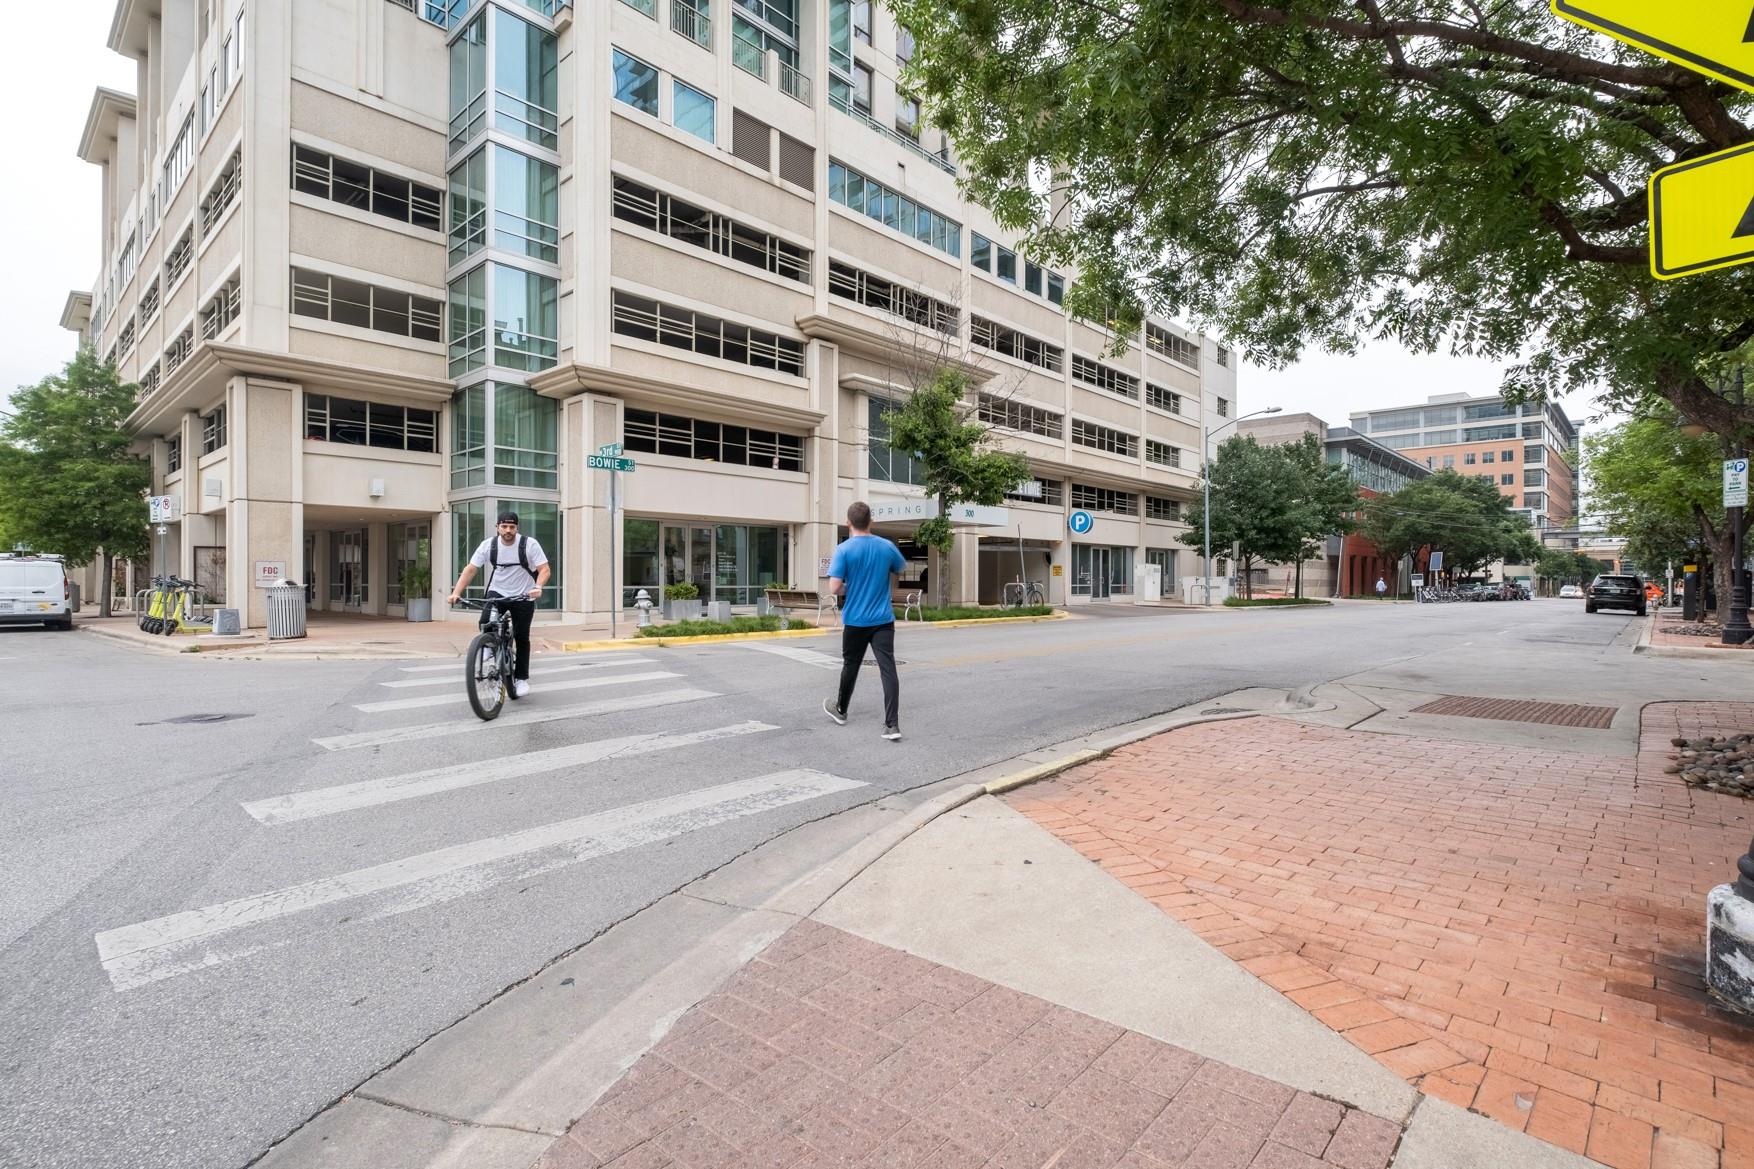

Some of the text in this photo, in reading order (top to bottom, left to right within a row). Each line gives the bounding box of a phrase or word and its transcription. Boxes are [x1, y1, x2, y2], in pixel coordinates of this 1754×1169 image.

[602, 446, 612, 456] 3rd
[589, 457, 620, 469] BOWIE
[871, 505, 921, 516] SPRING
[1075, 514, 1086, 530] P
